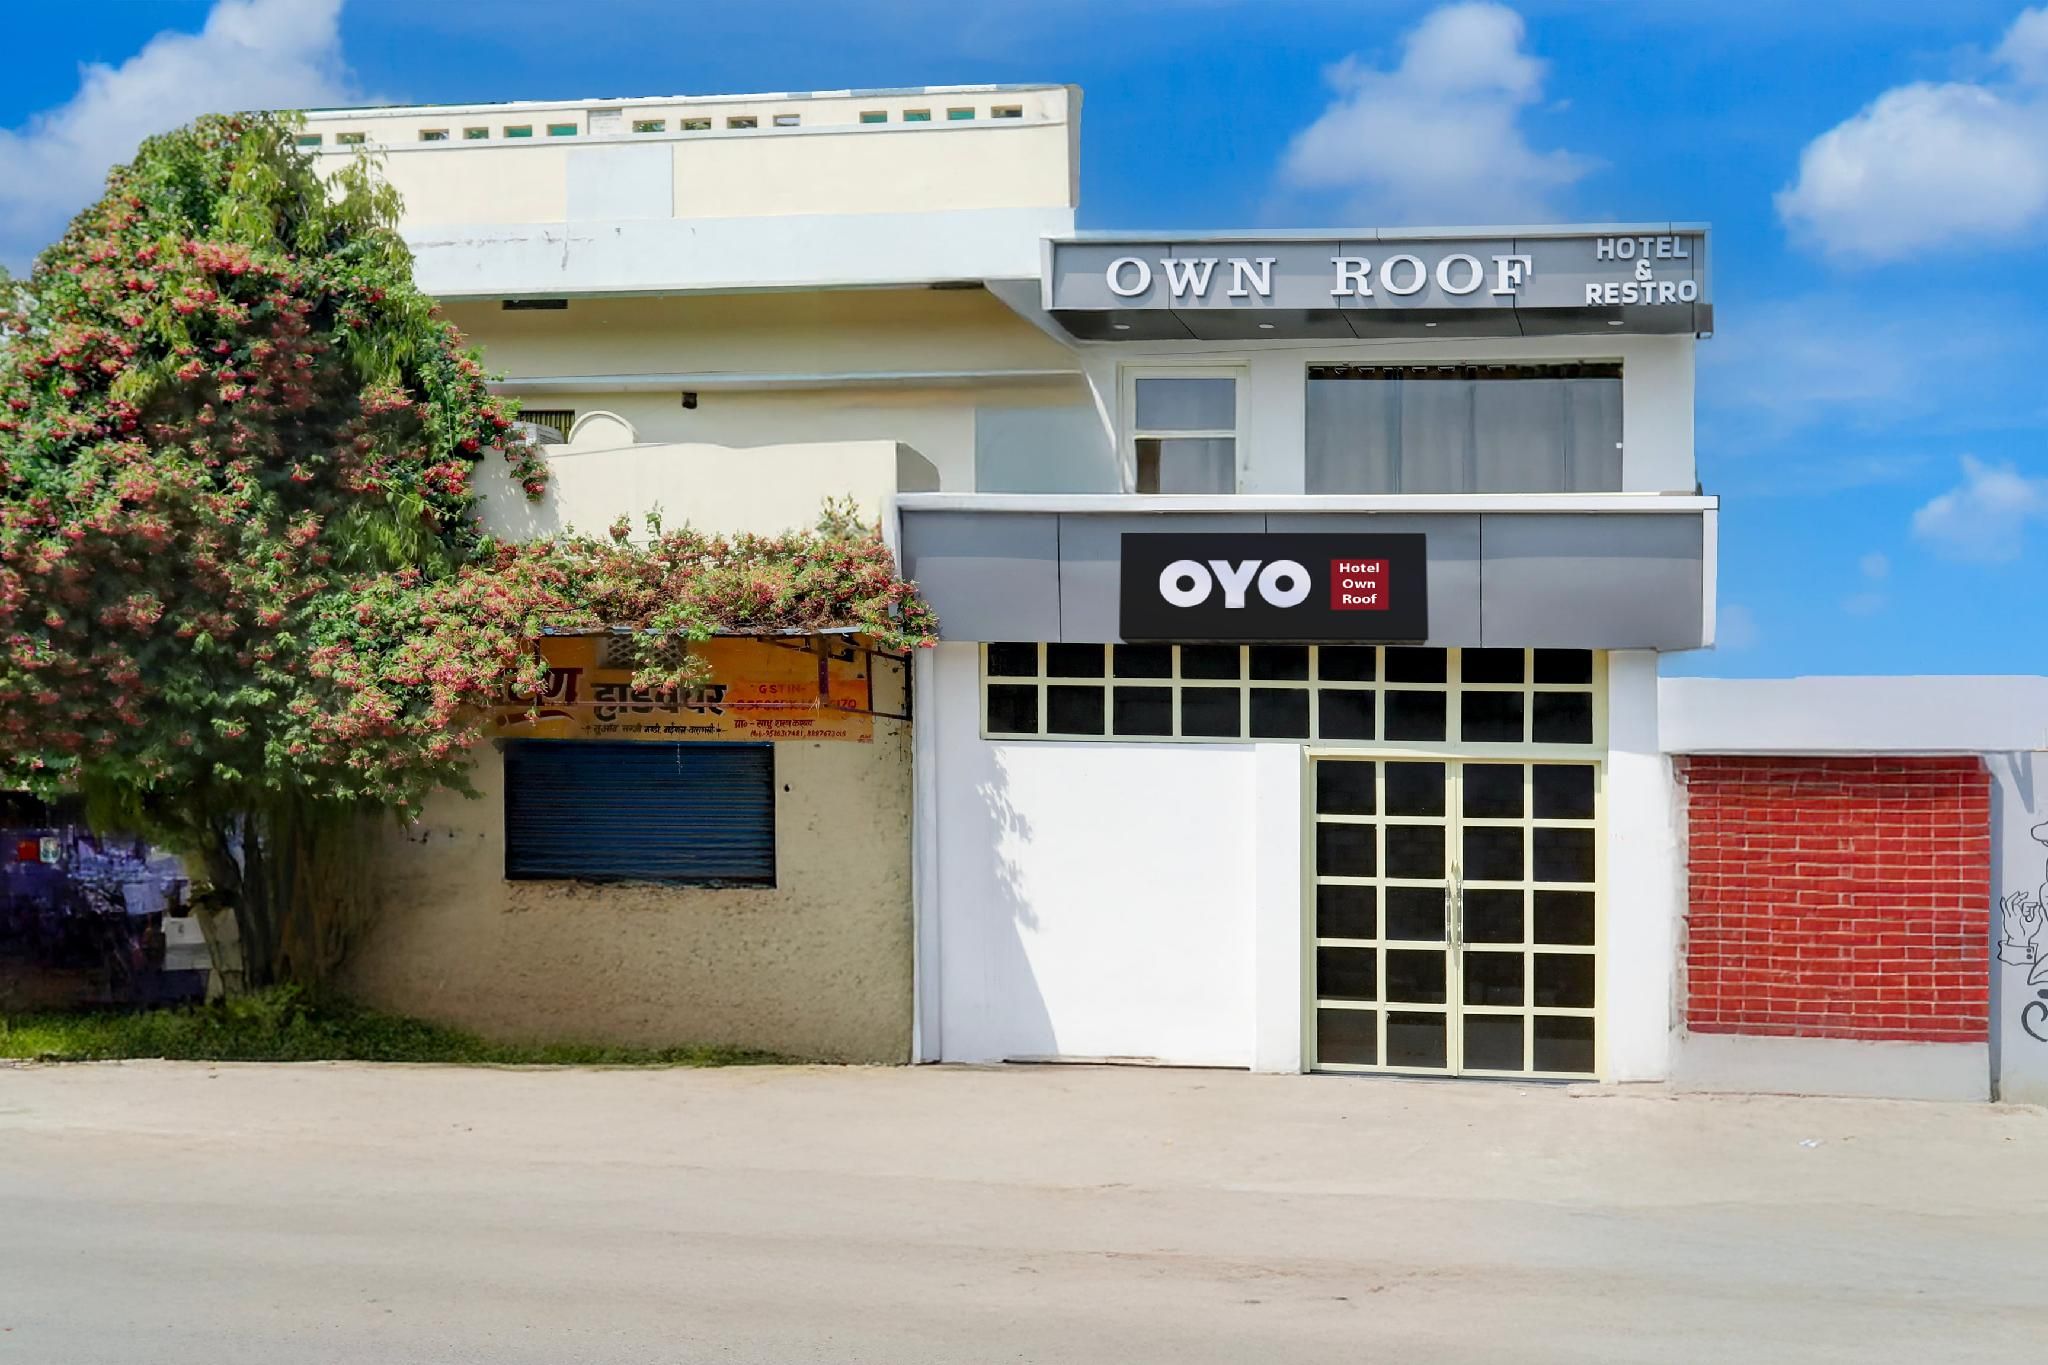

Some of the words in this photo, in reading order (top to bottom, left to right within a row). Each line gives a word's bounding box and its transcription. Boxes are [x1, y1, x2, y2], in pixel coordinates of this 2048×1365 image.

[1597, 236, 1688, 260] HOTEL
[1106, 256, 1277, 297] OWN
[1330, 254, 1532, 296] ROOF
[1635, 259, 1653, 281] &
[1586, 280, 1697, 305] RESTRO
[1339, 562, 1380, 573] Hotel
[1159, 559, 1312, 608] OYO
[1342, 578, 1376, 589] Own
[1342, 593, 1378, 604] Roof
